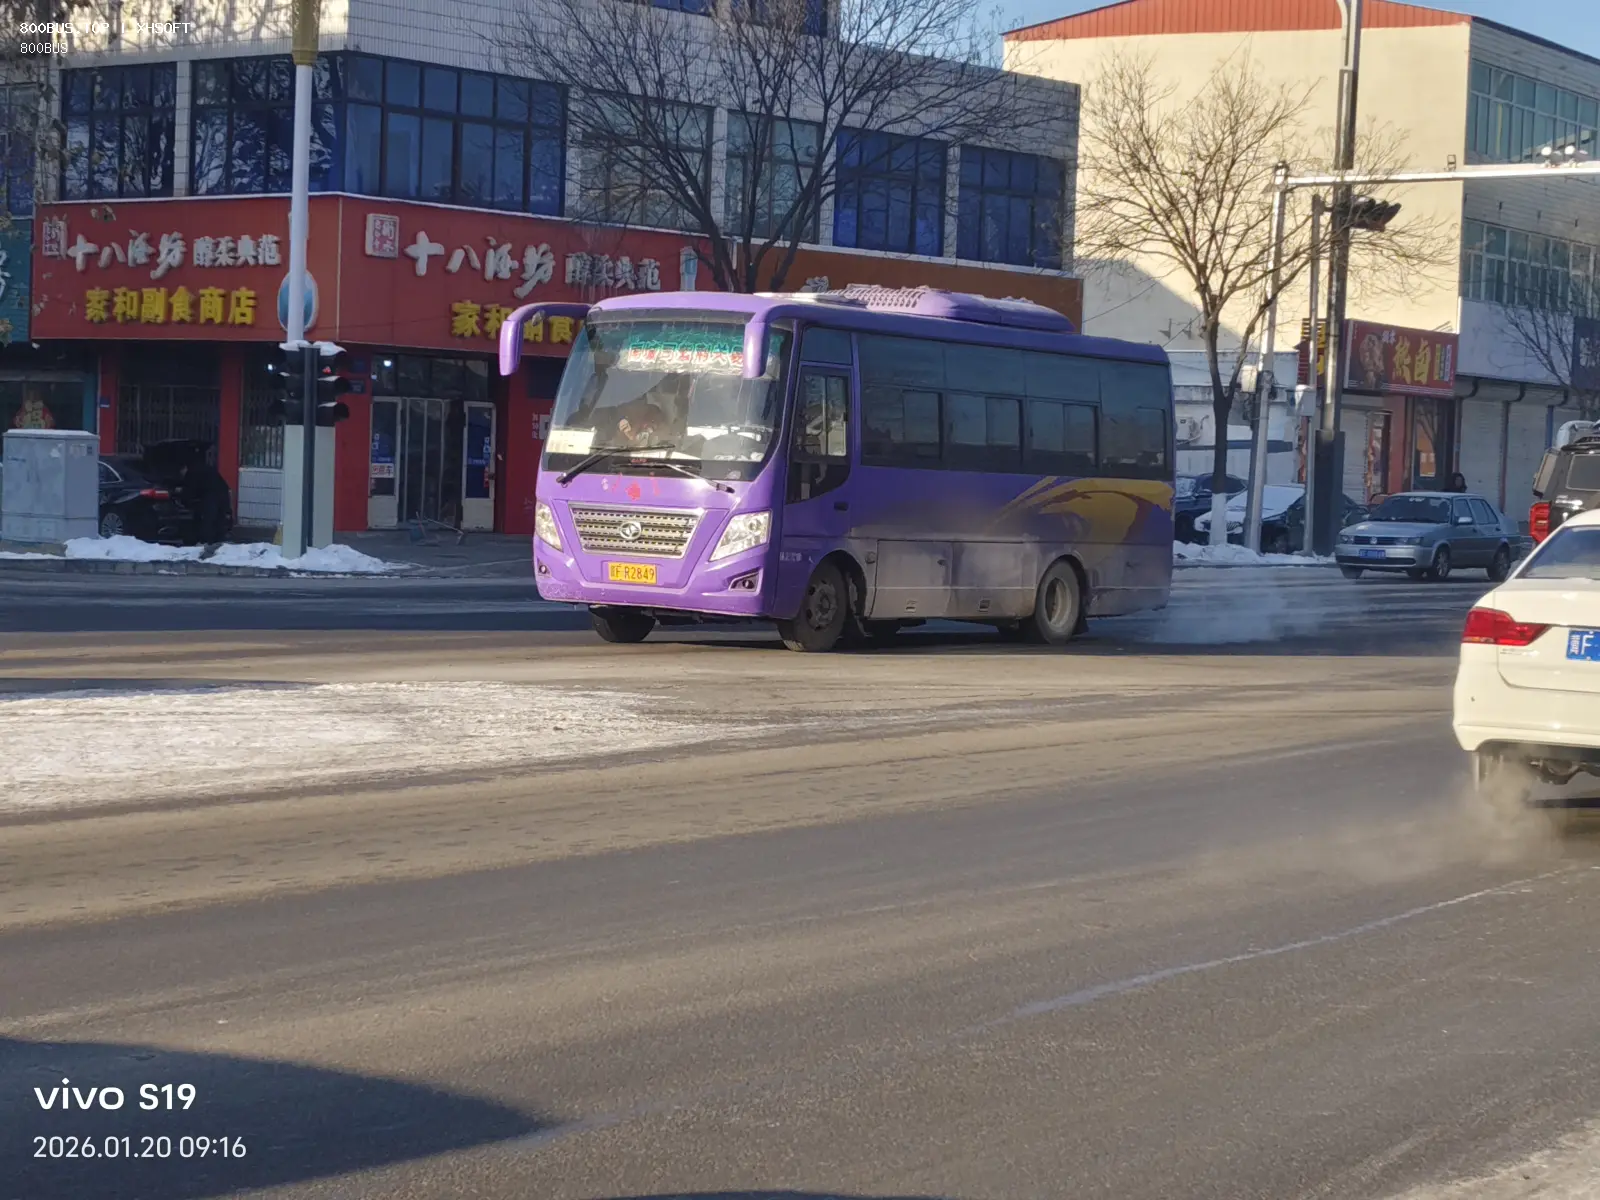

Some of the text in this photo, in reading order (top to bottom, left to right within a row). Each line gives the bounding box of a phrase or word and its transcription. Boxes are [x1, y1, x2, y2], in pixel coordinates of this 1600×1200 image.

[67, 229, 188, 280] 十八酒坊
[404, 230, 556, 300] 十八酒坊
[85, 286, 257, 325] 家和副食商店
[451, 300, 583, 344] 家和食
